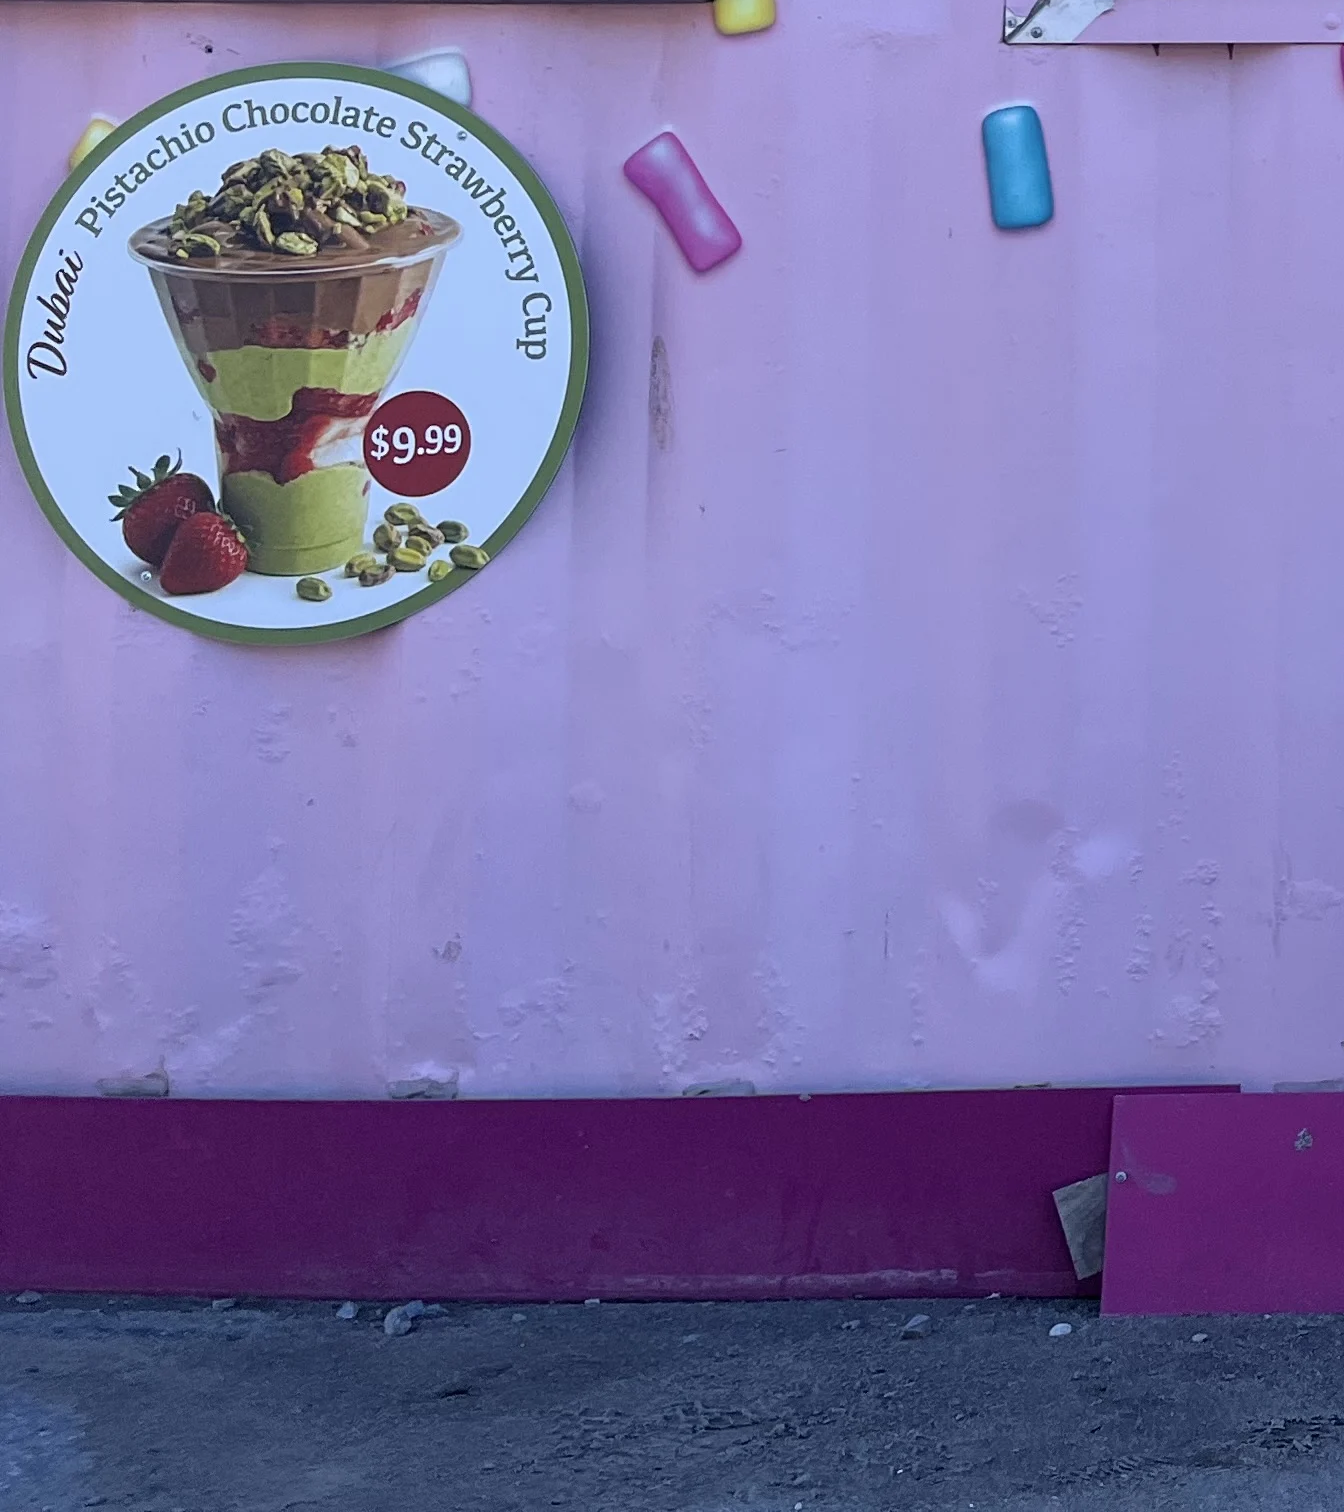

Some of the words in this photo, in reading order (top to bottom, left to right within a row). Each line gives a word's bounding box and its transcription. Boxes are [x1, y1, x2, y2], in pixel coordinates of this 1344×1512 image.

[27, 249, 85, 381] Dubai
[75, 120, 215, 238] Pistachio
[222, 96, 397, 139] Chocolate
[399, 121, 540, 285] Strawberry
[515, 291, 553, 361] Cup
[370, 424, 462, 465] $9.99
